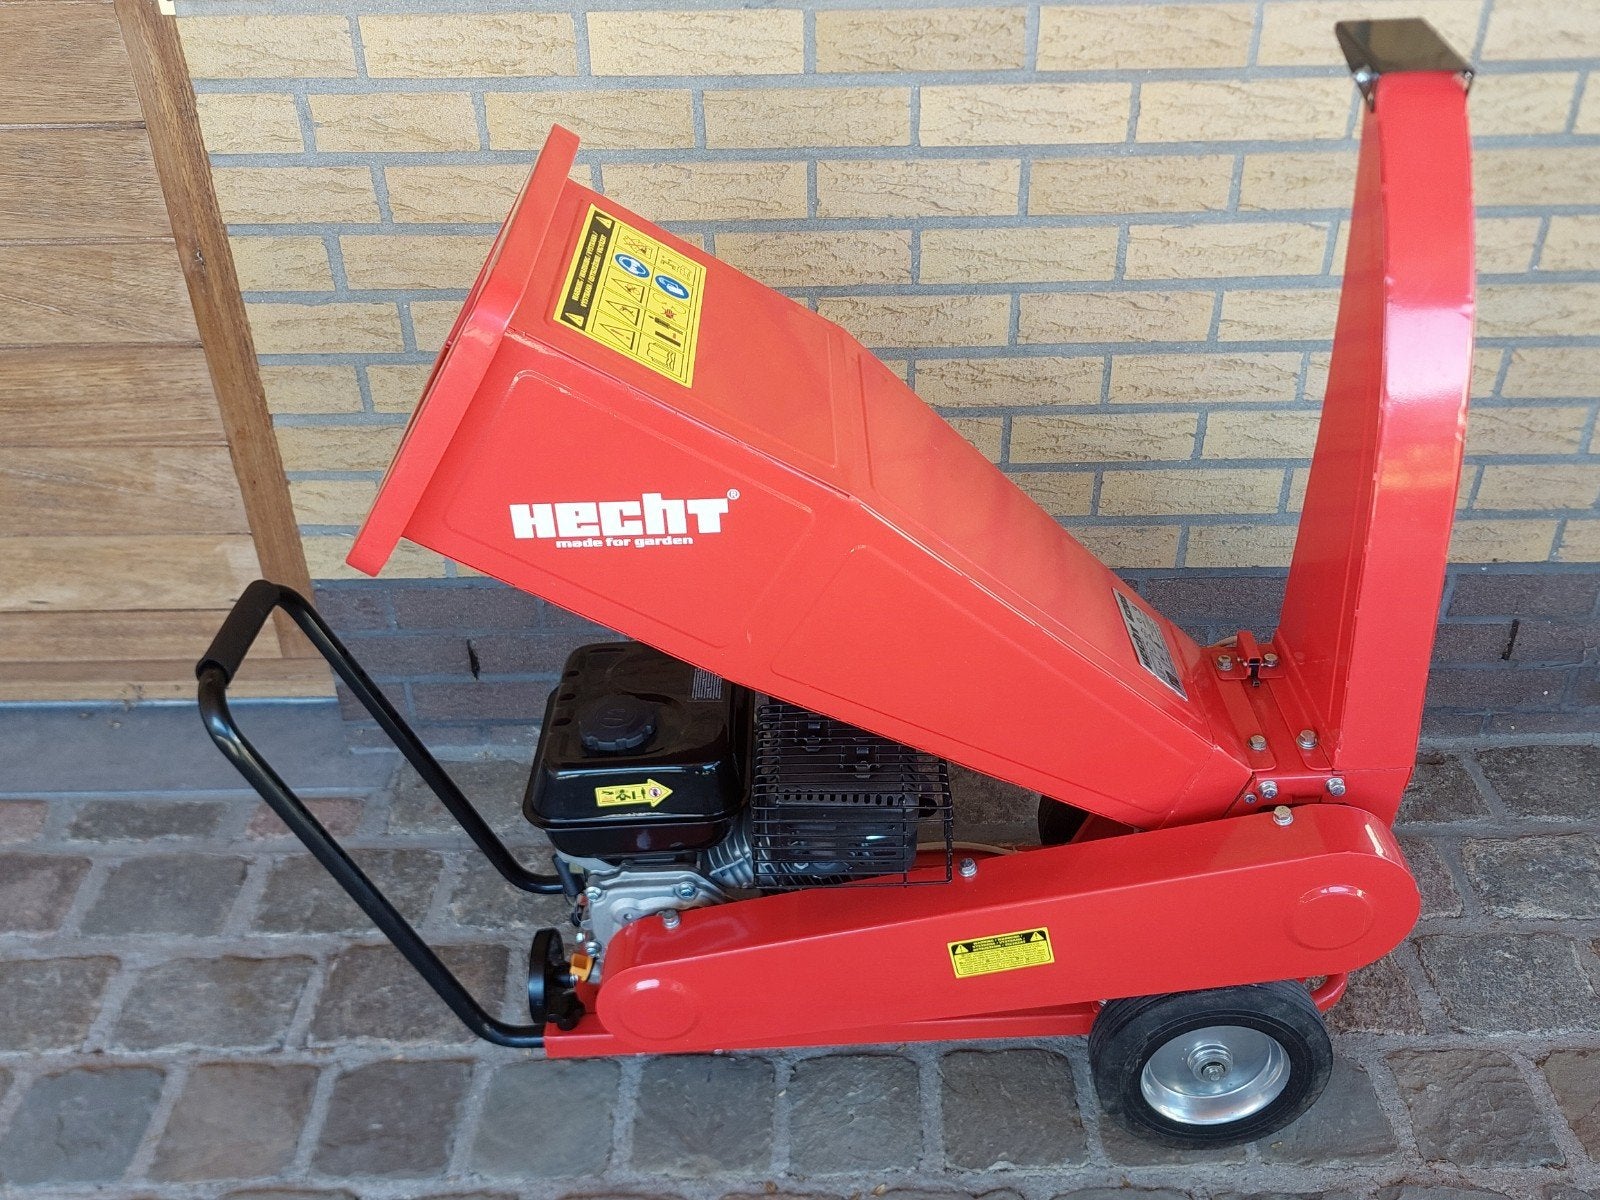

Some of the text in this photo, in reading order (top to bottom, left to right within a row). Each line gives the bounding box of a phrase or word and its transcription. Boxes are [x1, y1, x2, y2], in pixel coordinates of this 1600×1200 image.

[555, 535, 694, 549] made for garden
